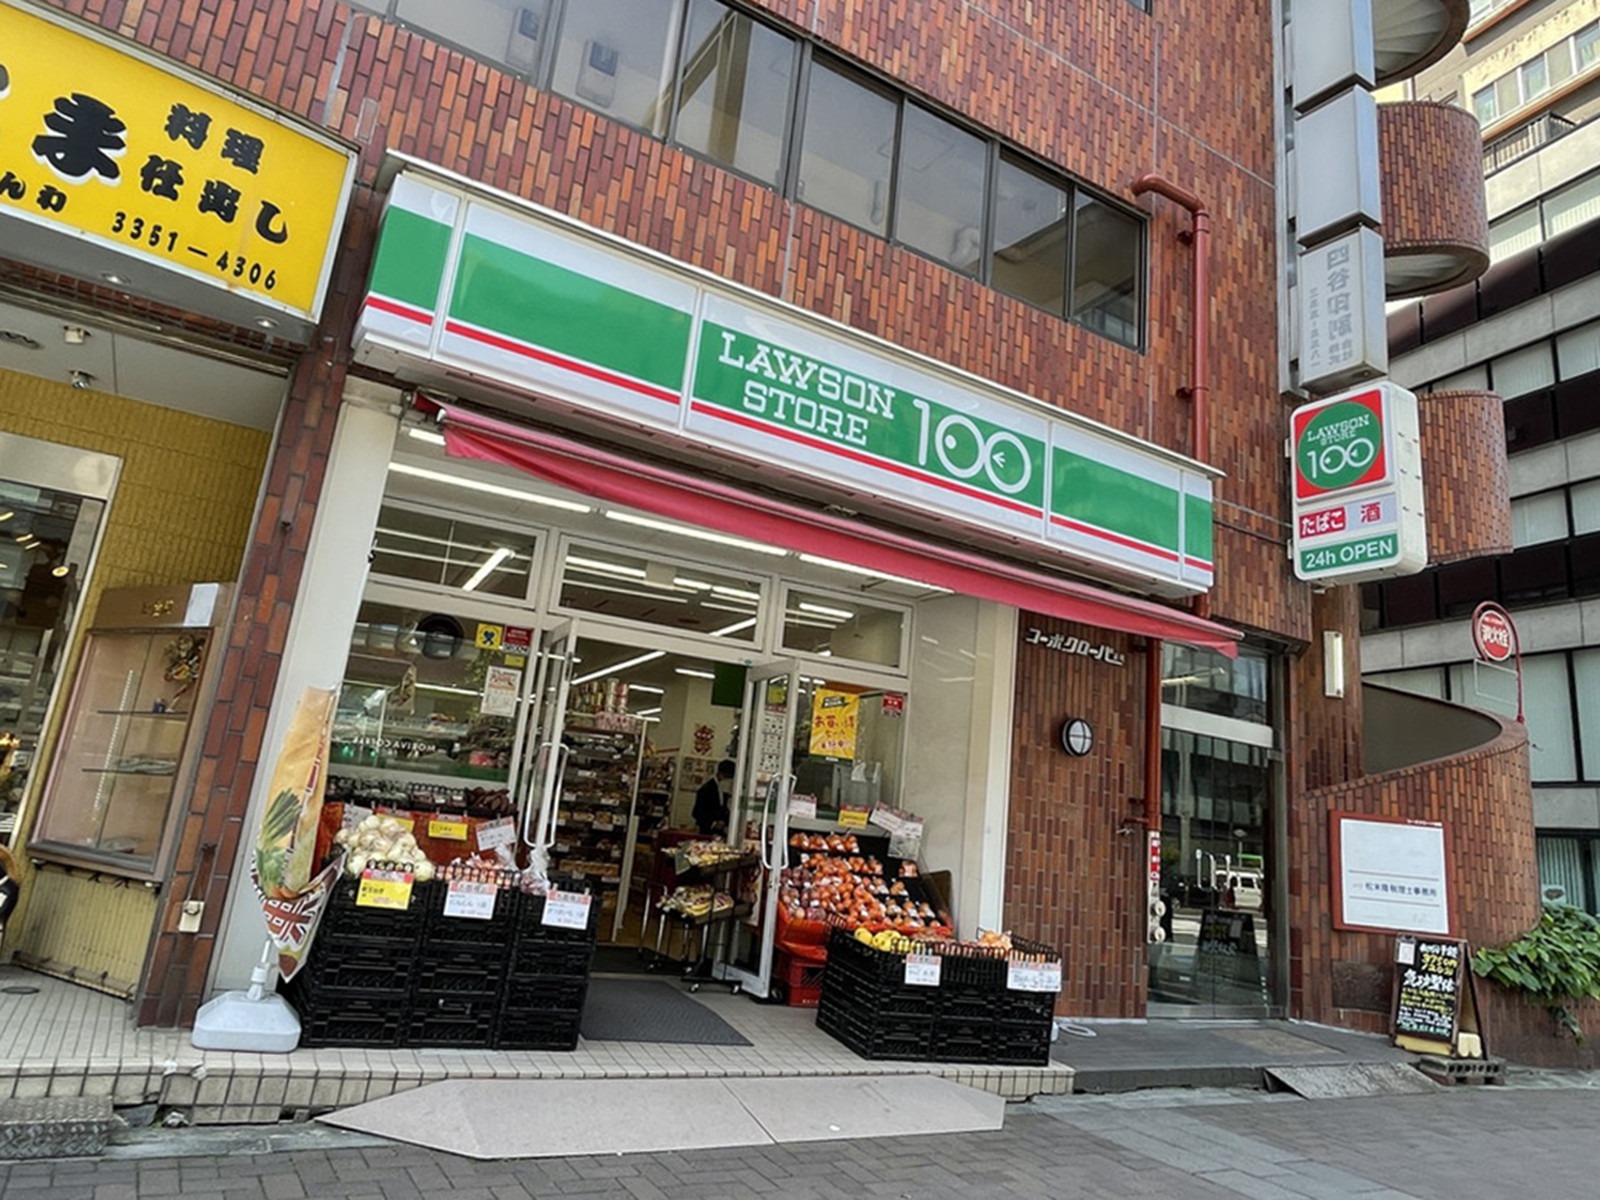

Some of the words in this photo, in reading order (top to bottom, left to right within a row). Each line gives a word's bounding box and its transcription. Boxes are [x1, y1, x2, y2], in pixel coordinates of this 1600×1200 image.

[165, 103, 264, 174] 料理
[140, 154, 288, 244] 仕出し
[718, 331, 896, 420] LAWSON
[743, 380, 869, 447] STORE
[1306, 413, 1370, 443] LAWSON
[912, 398, 1032, 494] 100
[1307, 437, 1375, 479] 100
[1319, 429, 1357, 447] STORE
[1301, 510, 1345, 536] たばこ
[1361, 501, 1381, 524] 酒
[1305, 550, 1337, 569] 24h
[1339, 538, 1394, 563] OPEN
